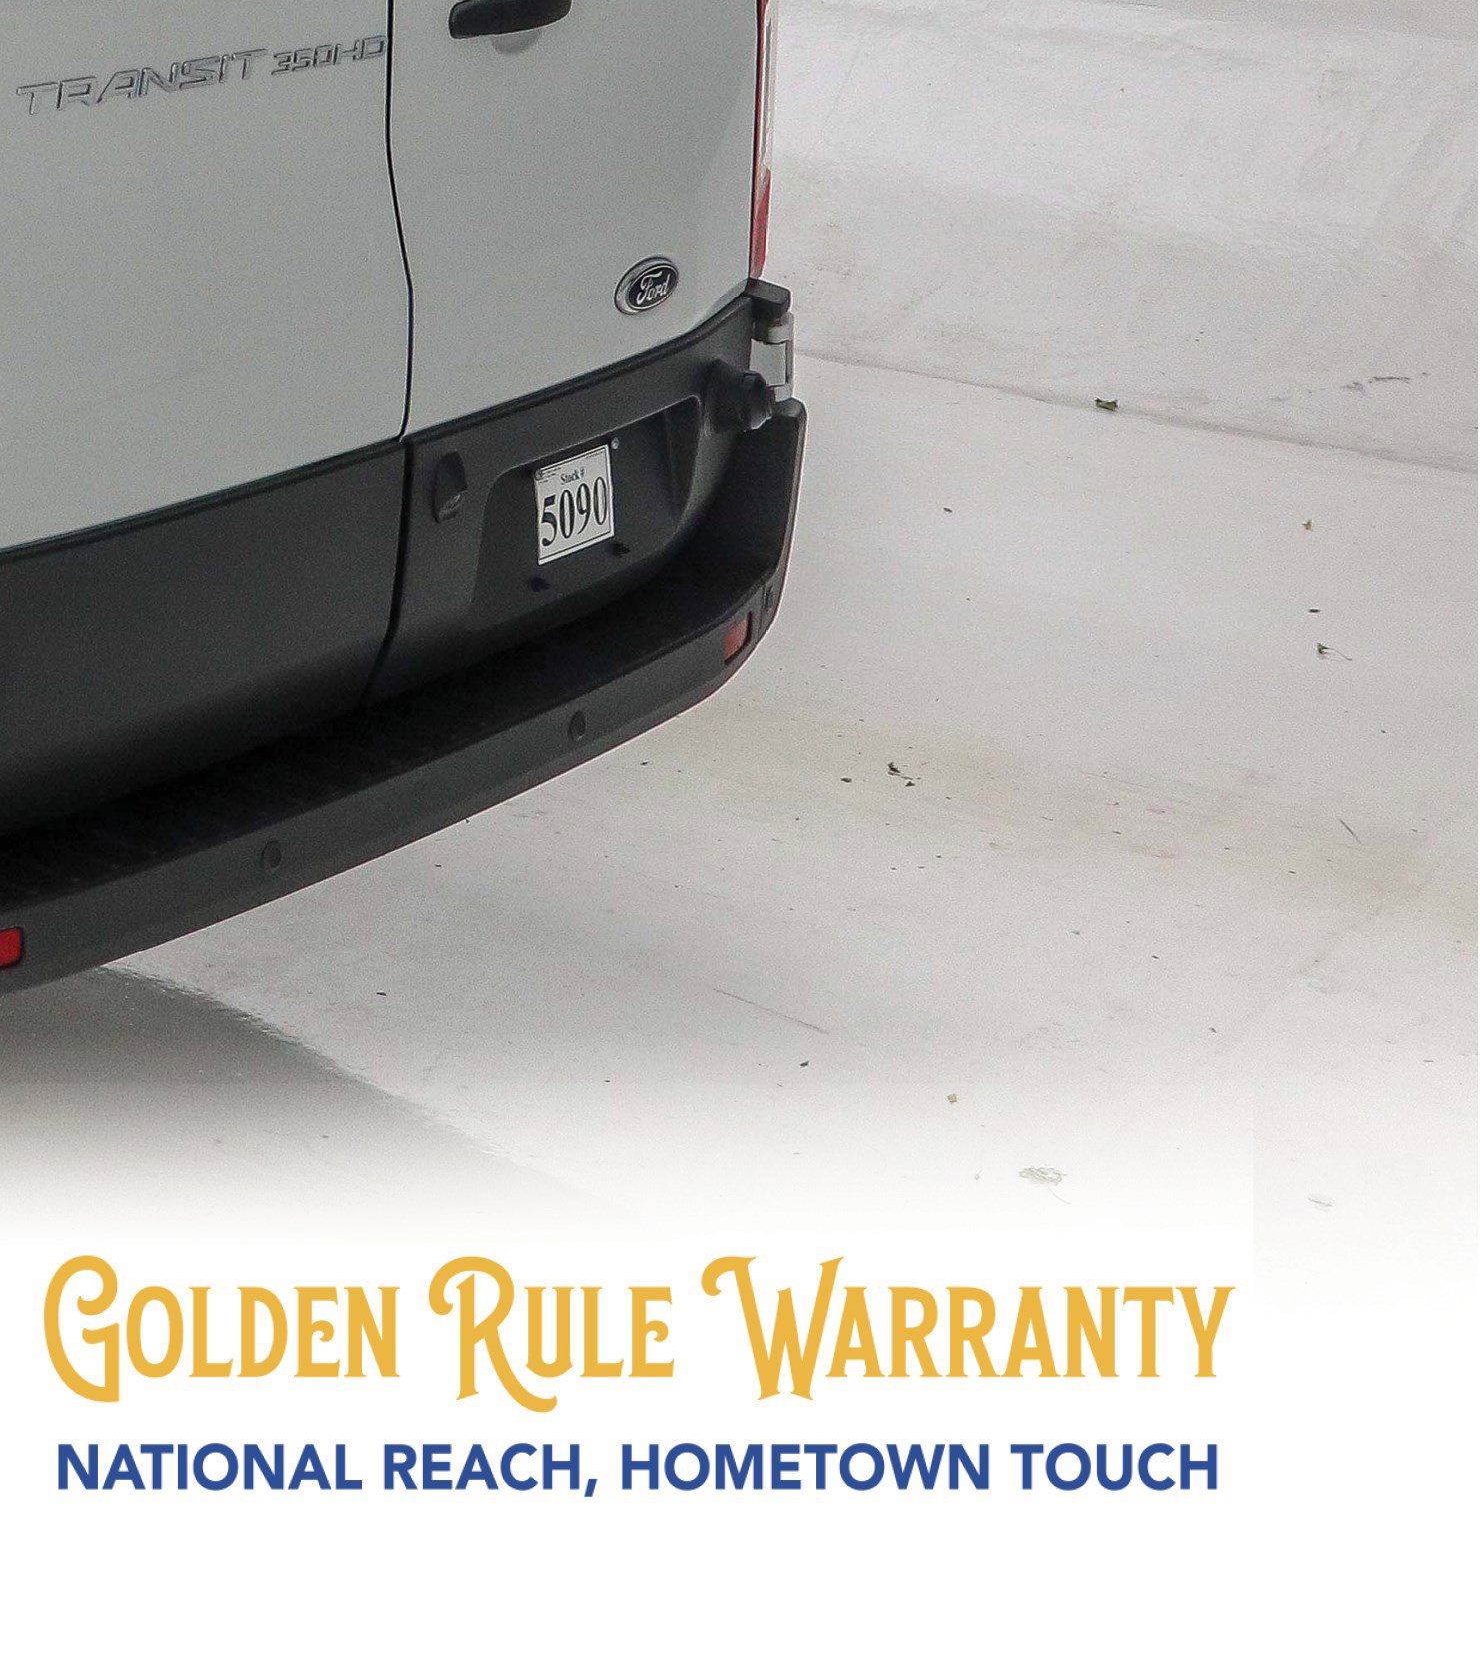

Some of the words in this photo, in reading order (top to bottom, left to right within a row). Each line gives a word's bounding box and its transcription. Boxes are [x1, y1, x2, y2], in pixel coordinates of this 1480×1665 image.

[16, 48, 267, 115] TRANSIT
[270, 35, 388, 75] 350HD
[636, 270, 671, 305] Ford
[541, 476, 608, 547] 5090
